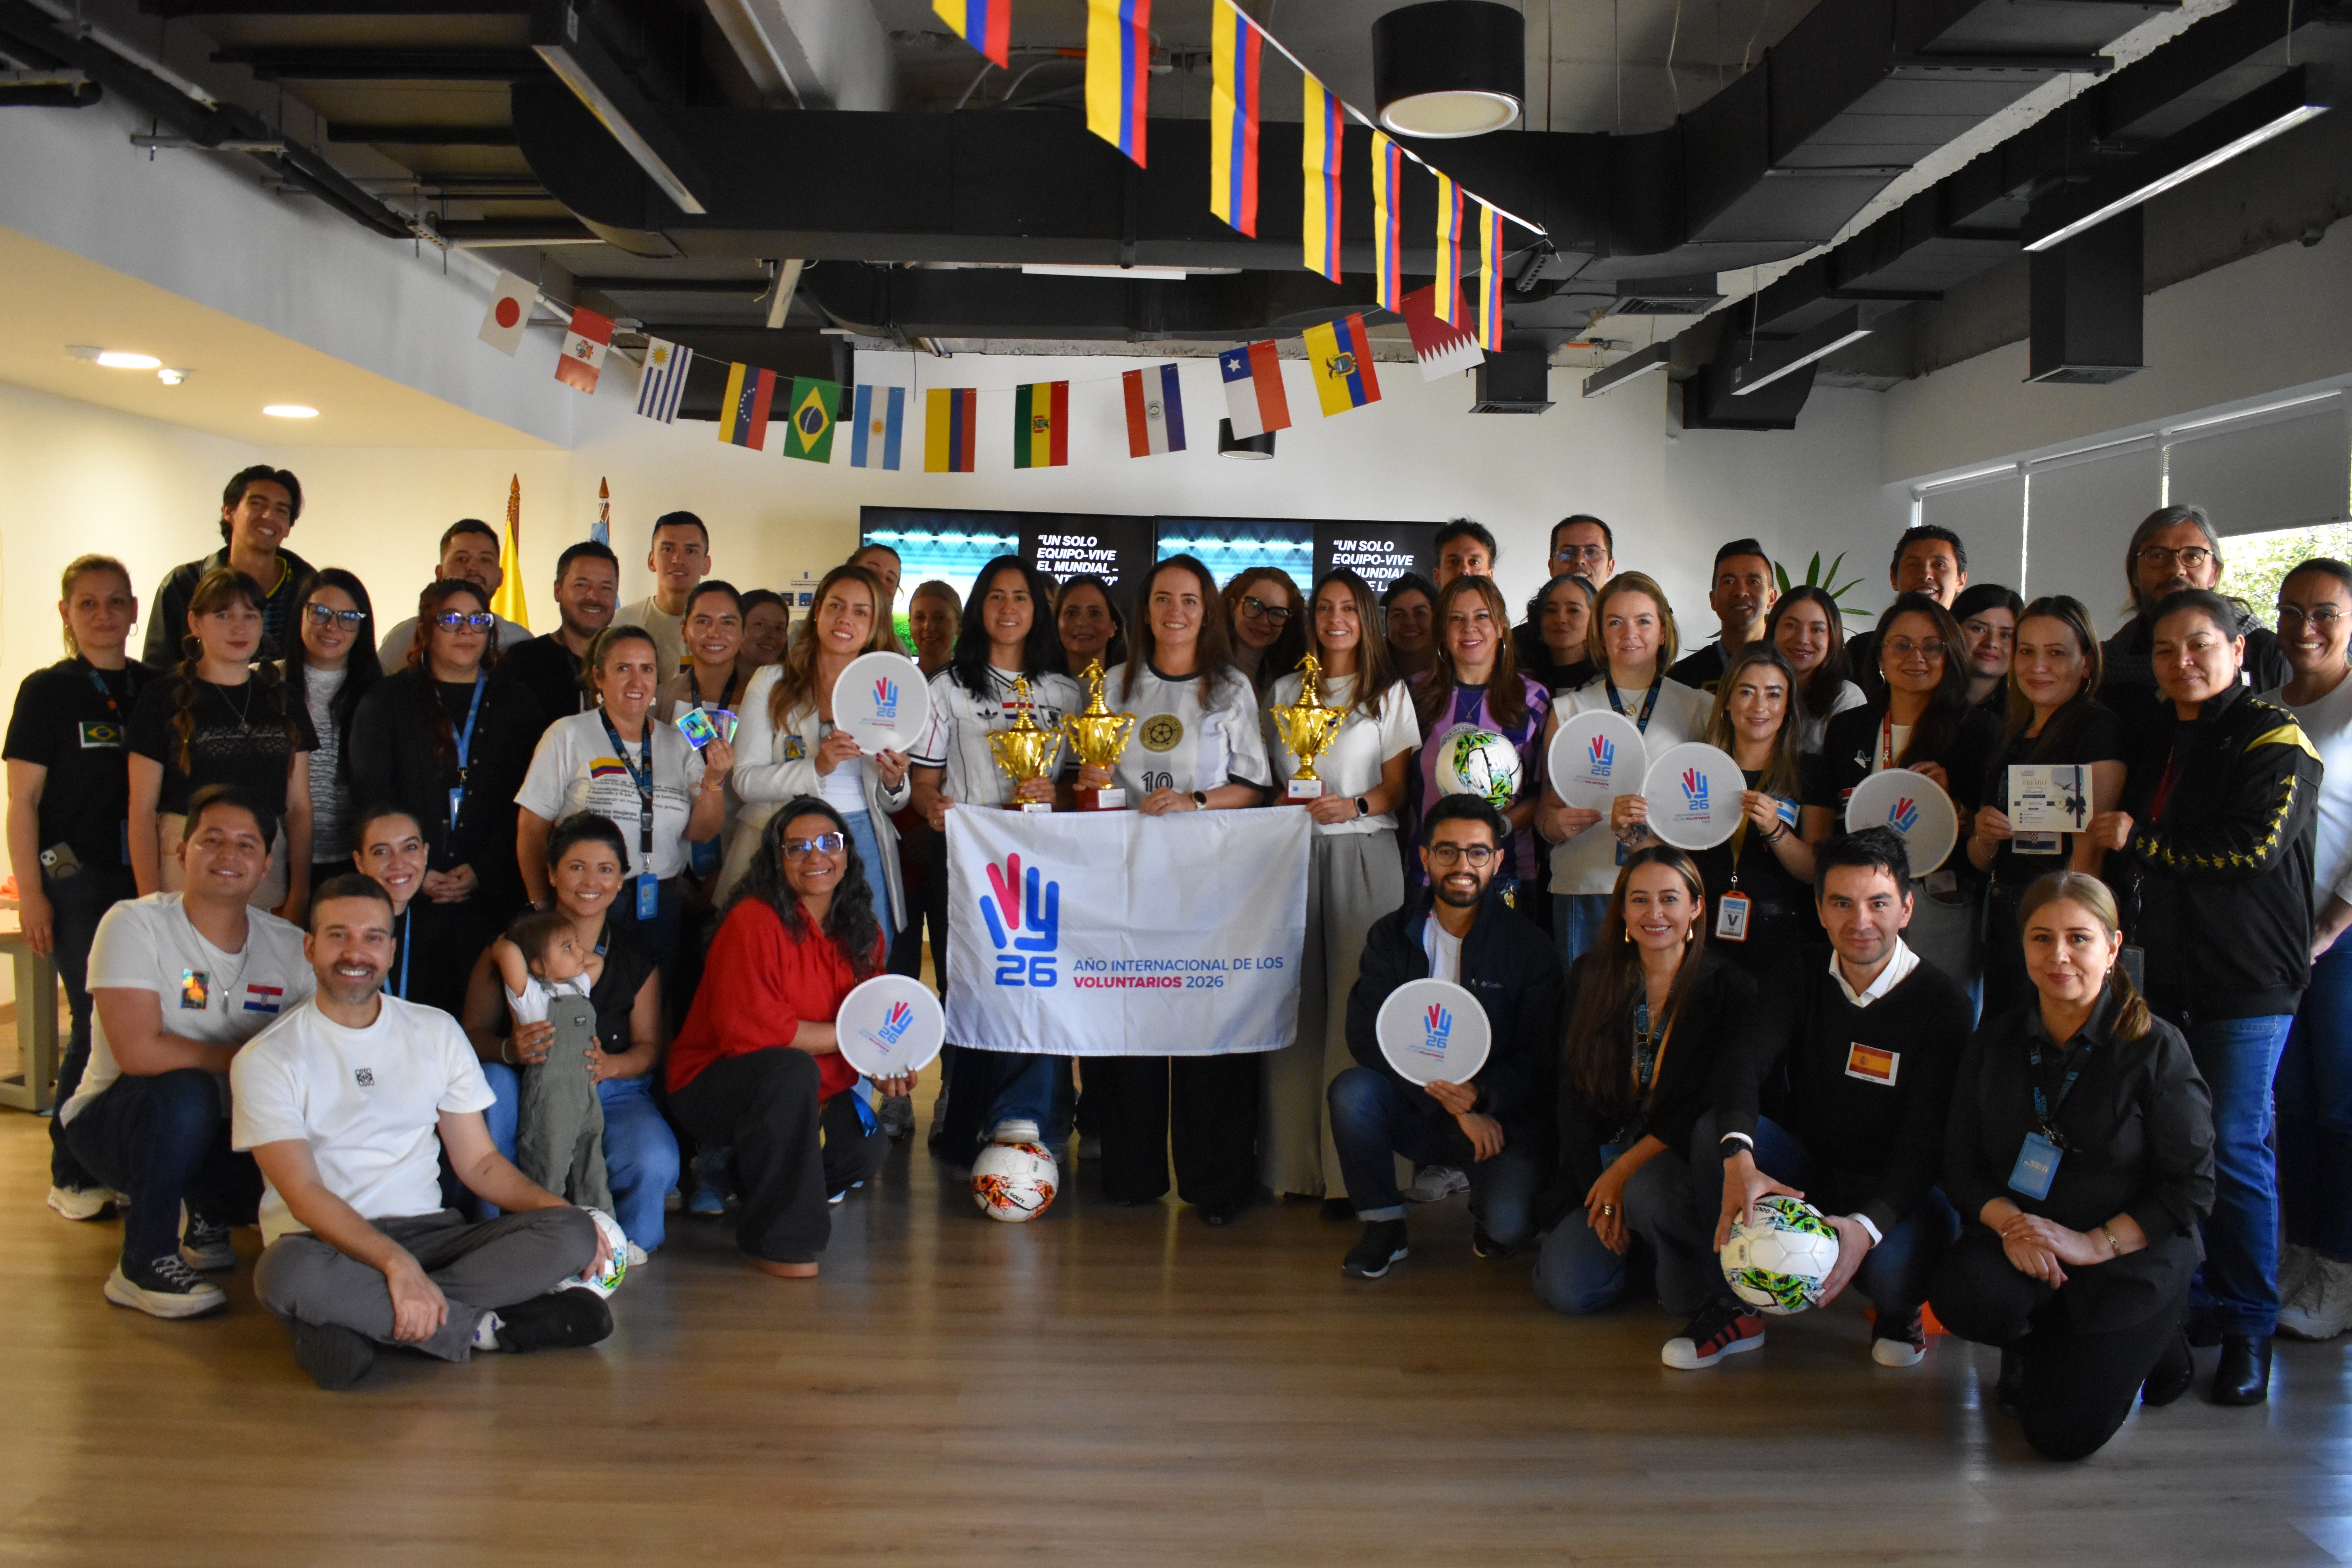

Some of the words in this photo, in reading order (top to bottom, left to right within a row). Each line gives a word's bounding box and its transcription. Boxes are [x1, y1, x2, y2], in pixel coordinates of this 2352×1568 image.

[1038, 535, 1061, 546] “UN
[1062, 536, 1097, 547] SOLO
[1333, 540, 1357, 551] “UN
[1358, 541, 1394, 552] SOLO
[1037, 548, 1117, 560] EQUIPO-VIVE
[1332, 553, 1414, 566] EQUIPO-VIVE
[1037, 560, 1052, 571] EL
[1054, 561, 1110, 573] MUNDIAL
[1591, 765, 1611, 776] 26
[1141, 771, 1173, 792] 10
[1689, 799, 1709, 810] 26
[1728, 914, 1739, 926] V
[995, 954, 1058, 988] 26
[1074, 957, 1107, 972] AÑO
[1111, 958, 1229, 972] INTERNACIONAL
[1233, 958, 1252, 970] DE
[1256, 957, 1283, 969] LOS
[1073, 975, 1182, 988] VOLUNTARIOS
[1186, 975, 1224, 988] 2026
[878, 1027, 899, 1044] 26
[1425, 1035, 1447, 1049] 26
[1010, 1193, 1025, 1203] GOLTY
